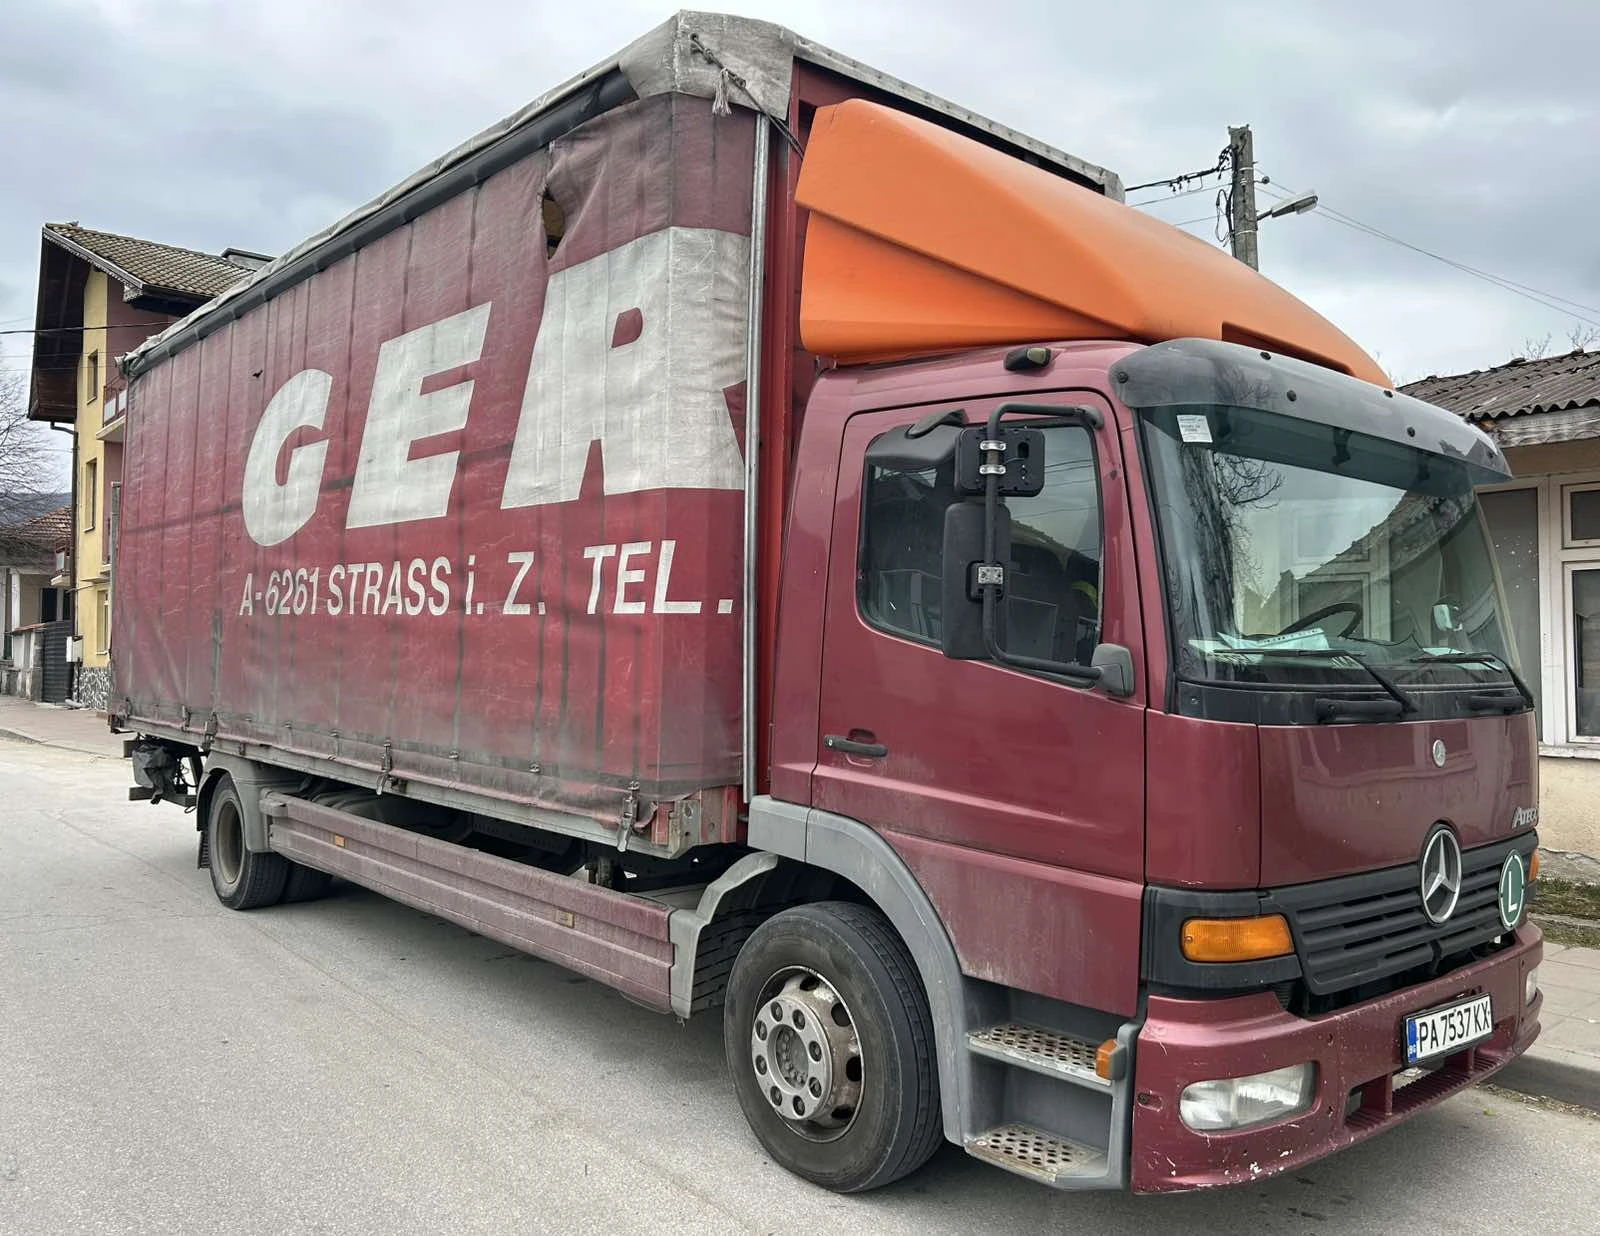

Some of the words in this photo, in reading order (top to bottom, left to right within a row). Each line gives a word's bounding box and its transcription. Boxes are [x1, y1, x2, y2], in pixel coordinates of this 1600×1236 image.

[242, 226, 748, 547] GER
[239, 566, 320, 616] A-6261
[327, 556, 452, 616] STRASS
[465, 554, 485, 615] i.
[502, 551, 546, 615] Z.
[583, 539, 734, 614] TEL.
[1508, 870, 1518, 913] L
